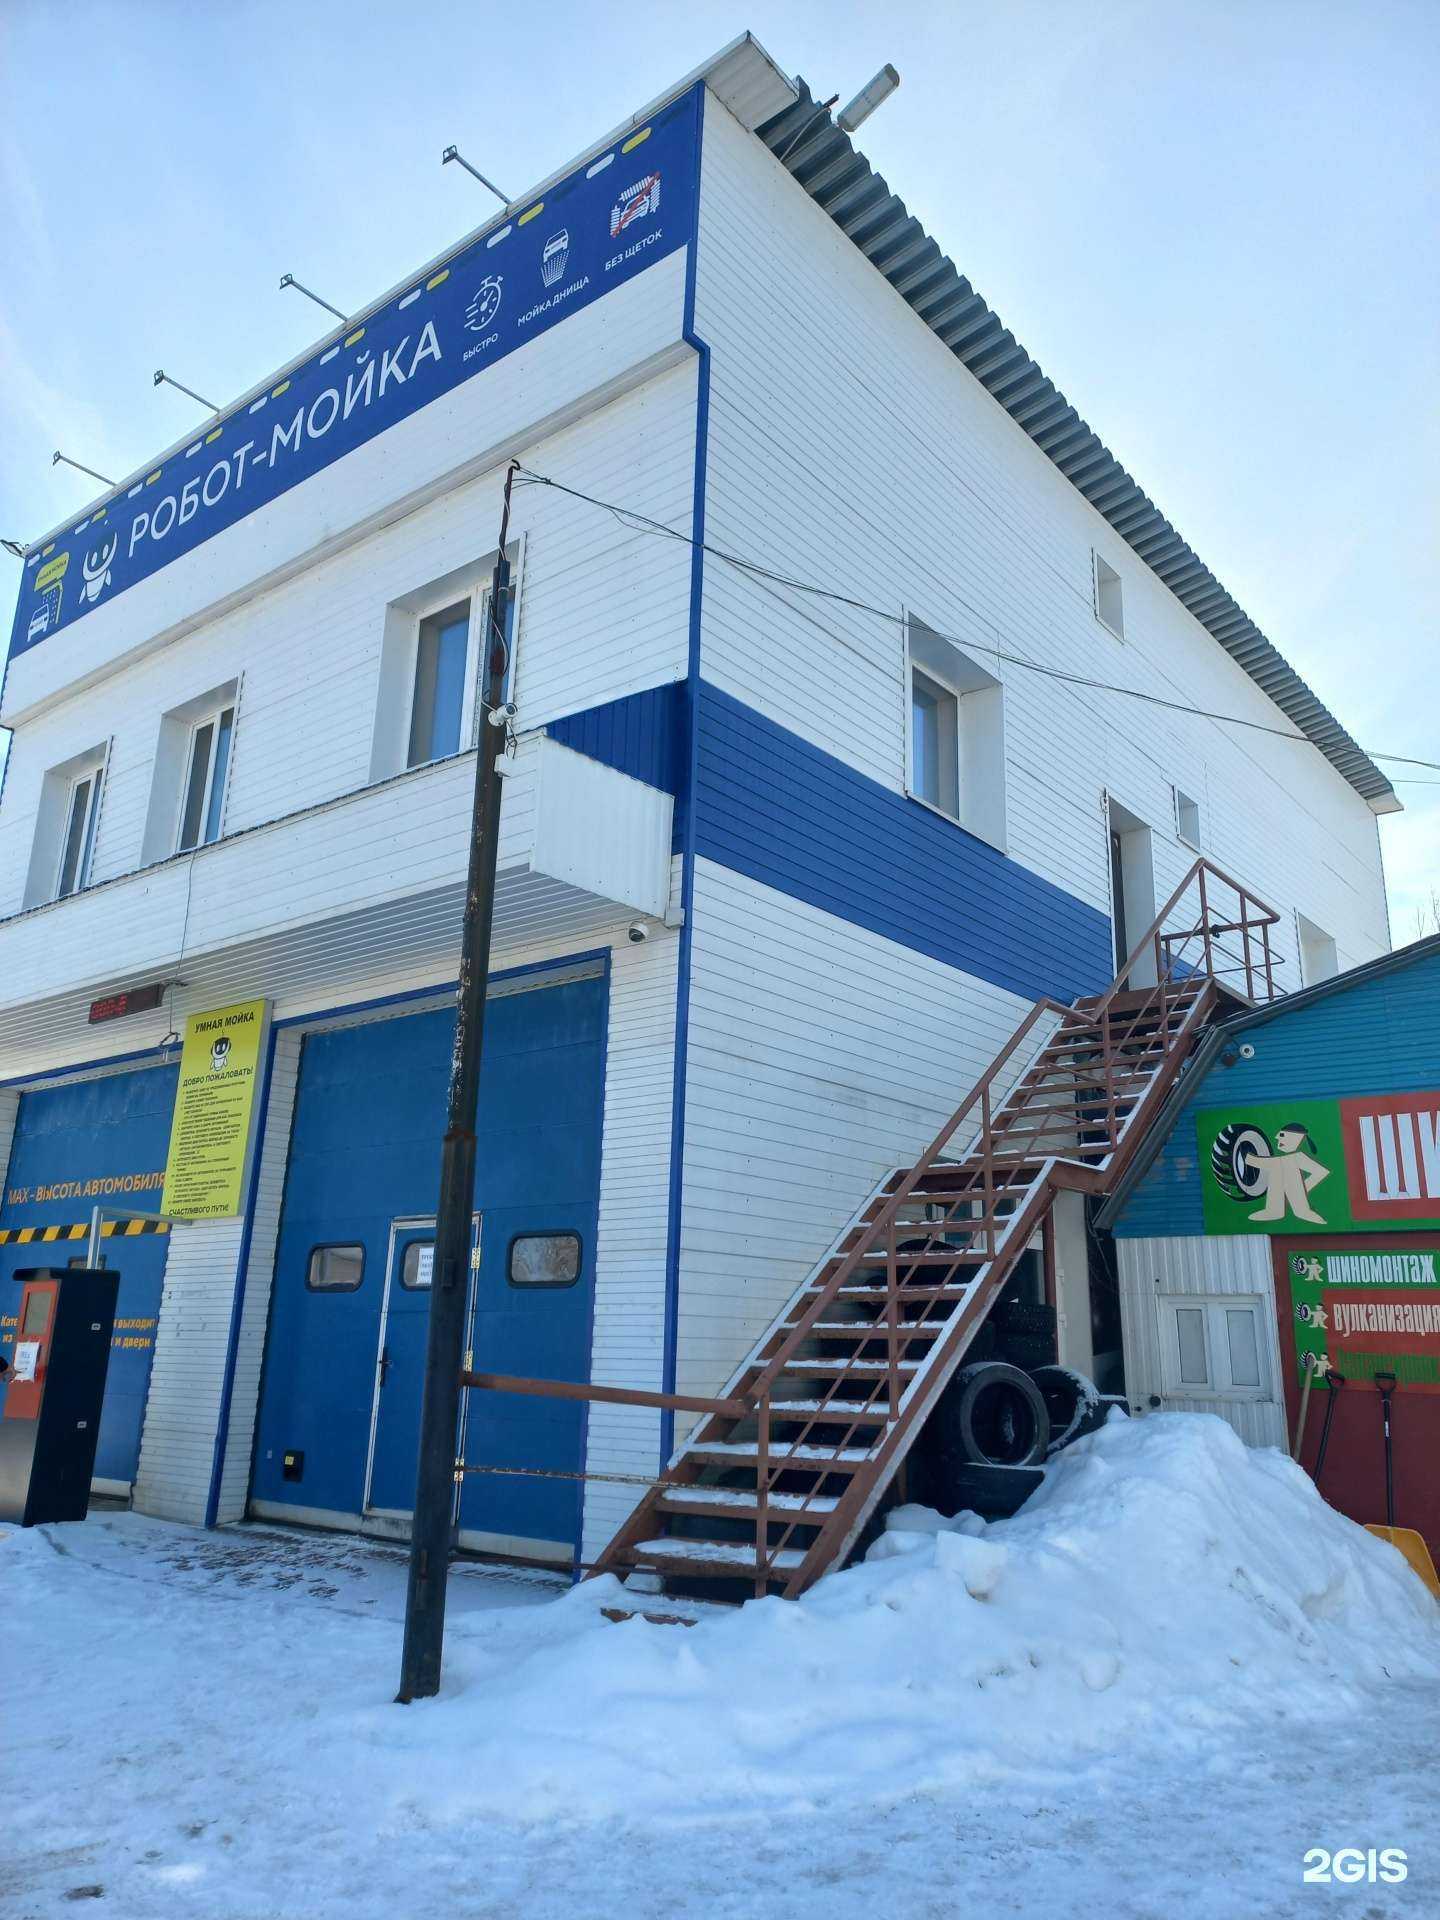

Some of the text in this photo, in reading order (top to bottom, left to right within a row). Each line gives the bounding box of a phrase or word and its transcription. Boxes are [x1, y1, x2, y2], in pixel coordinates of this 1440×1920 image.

[605, 228, 664, 271] БЕЗ ЩЕТОК
[517, 275, 590, 327] МОЙКА ДНИЩА
[462, 333, 499, 361] БЫСТРО
[128, 320, 442, 558] РОБОТ-МОЙКА
[195, 1010, 255, 1034] УМНАЯ МОЙКА
[183, 1066, 254, 1088] ДОБРО ПОЖАЛОВАТЬ!
[83, 1172, 166, 1197] АВТОМОБИЛЯ
[122, 1337, 151, 1350] двери
